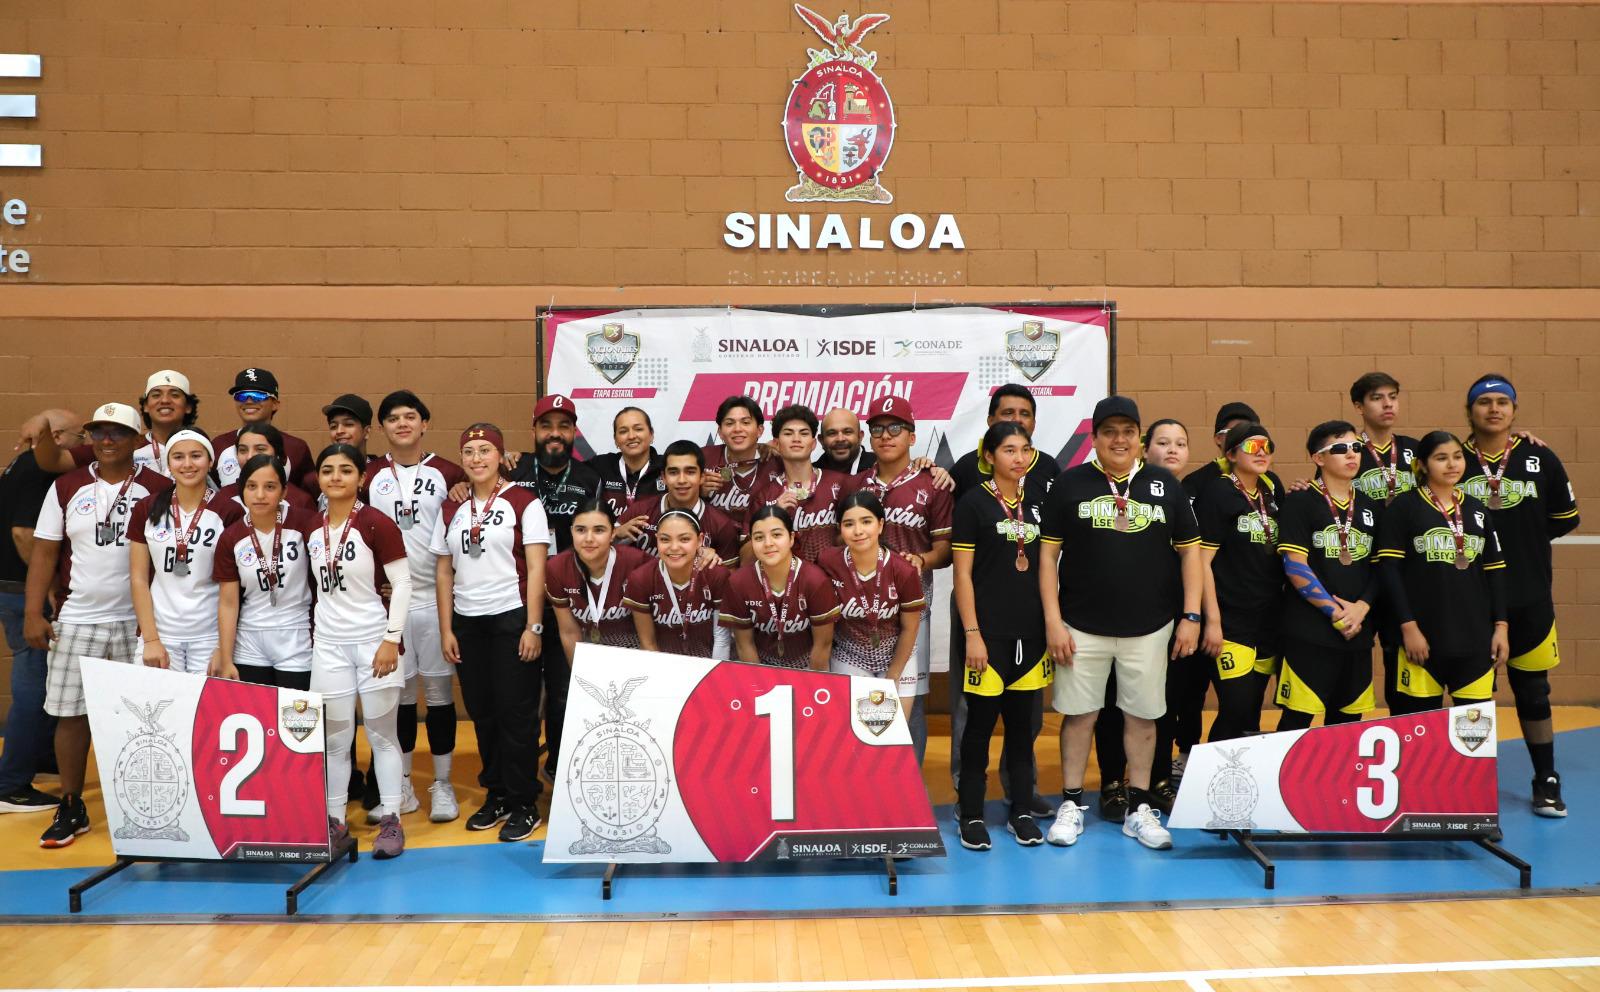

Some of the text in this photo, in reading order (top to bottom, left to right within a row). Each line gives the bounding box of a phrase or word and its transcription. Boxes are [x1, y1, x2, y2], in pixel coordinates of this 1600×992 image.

[816, 65, 863, 78] SINALOA
[825, 175, 853, 184] 1831
[723, 212, 966, 249] SINALOA
[718, 338, 963, 355] SINALOA ISDE CONADE
[593, 389, 634, 398] ETAPA ESTATAL
[1030, 387, 1053, 396] ESTATAL
[414, 478, 436, 496] 24
[482, 510, 505, 526] 25
[596, 727, 640, 738] SINALOA
[135, 739, 168, 748] SINALOA
[755, 685, 794, 821] 1
[219, 713, 265, 816] 2
[1356, 726, 1400, 820] 3
[792, 844, 841, 853] SINALOA
[861, 844, 887, 854] ISDE
